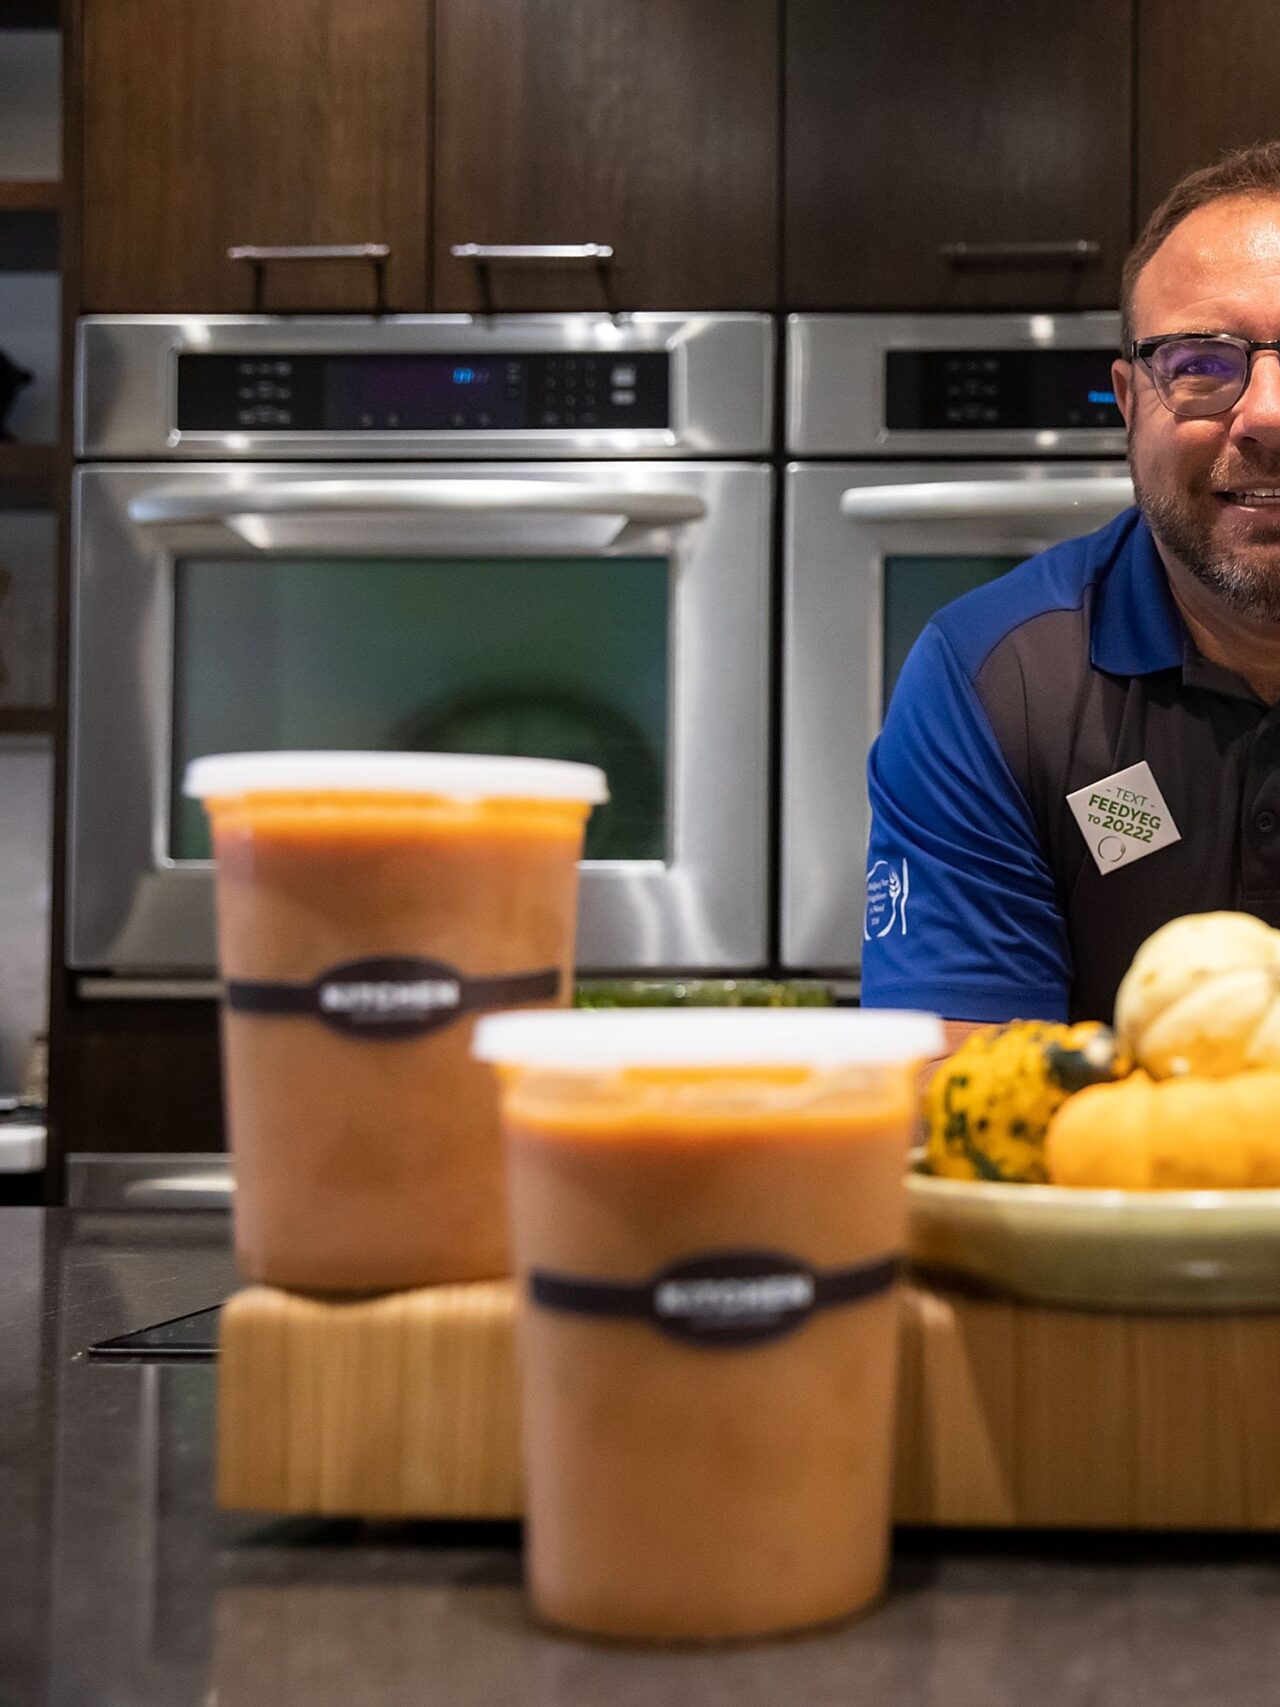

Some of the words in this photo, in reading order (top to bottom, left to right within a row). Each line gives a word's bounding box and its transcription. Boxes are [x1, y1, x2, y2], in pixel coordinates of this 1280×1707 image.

[1089, 794, 1161, 830] FEEDYEG
[1116, 787, 1149, 807] TEXT
[1087, 813, 1101, 825] TO
[1102, 815, 1154, 843] 20222
